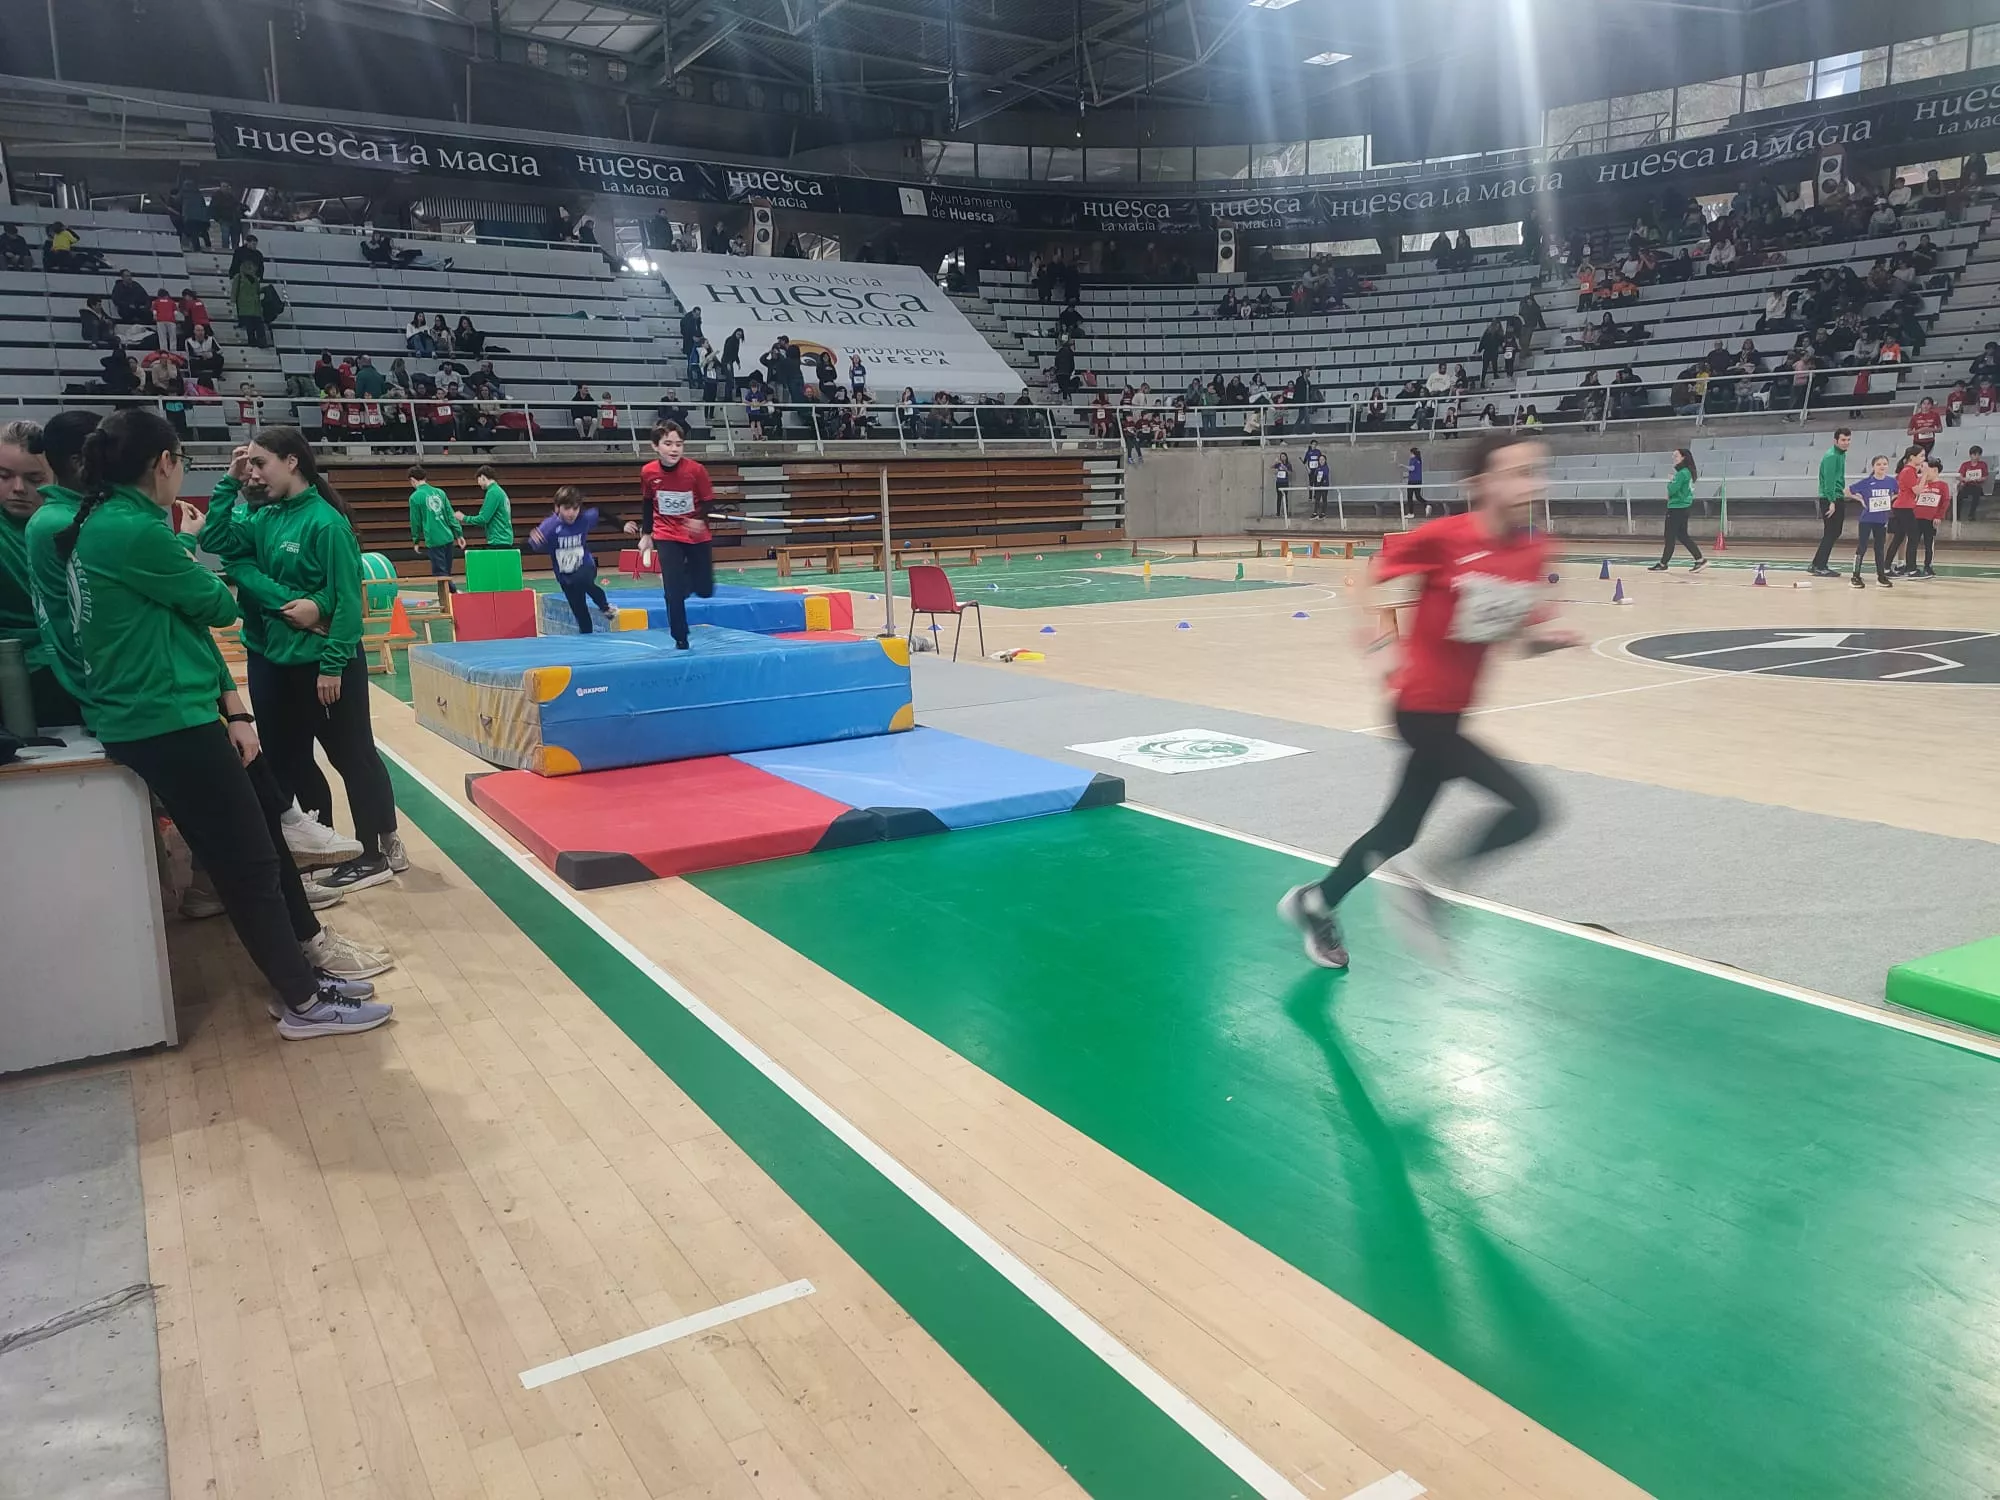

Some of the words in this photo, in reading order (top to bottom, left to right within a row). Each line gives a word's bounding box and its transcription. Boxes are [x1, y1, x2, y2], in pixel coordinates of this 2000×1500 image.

[234, 126, 383, 163] Huesca
[390, 143, 430, 166] La
[576, 154, 686, 183] Huesca
[1596, 146, 1715, 183] Huesca
[1724, 137, 1758, 163] La
[601, 180, 621, 193] La
[727, 169, 825, 197] Huesca
[929, 191, 1013, 210] Ayuntamiento
[1083, 200, 1171, 219] Huesca
[1210, 197, 1301, 217] Huesca
[1330, 190, 1434, 218] Huesca
[1441, 185, 1471, 207] La
[931, 206, 947, 220] de
[949, 208, 995, 224] Huesca
[701, 282, 935, 314] Huesca
[749, 305, 798, 324] La
